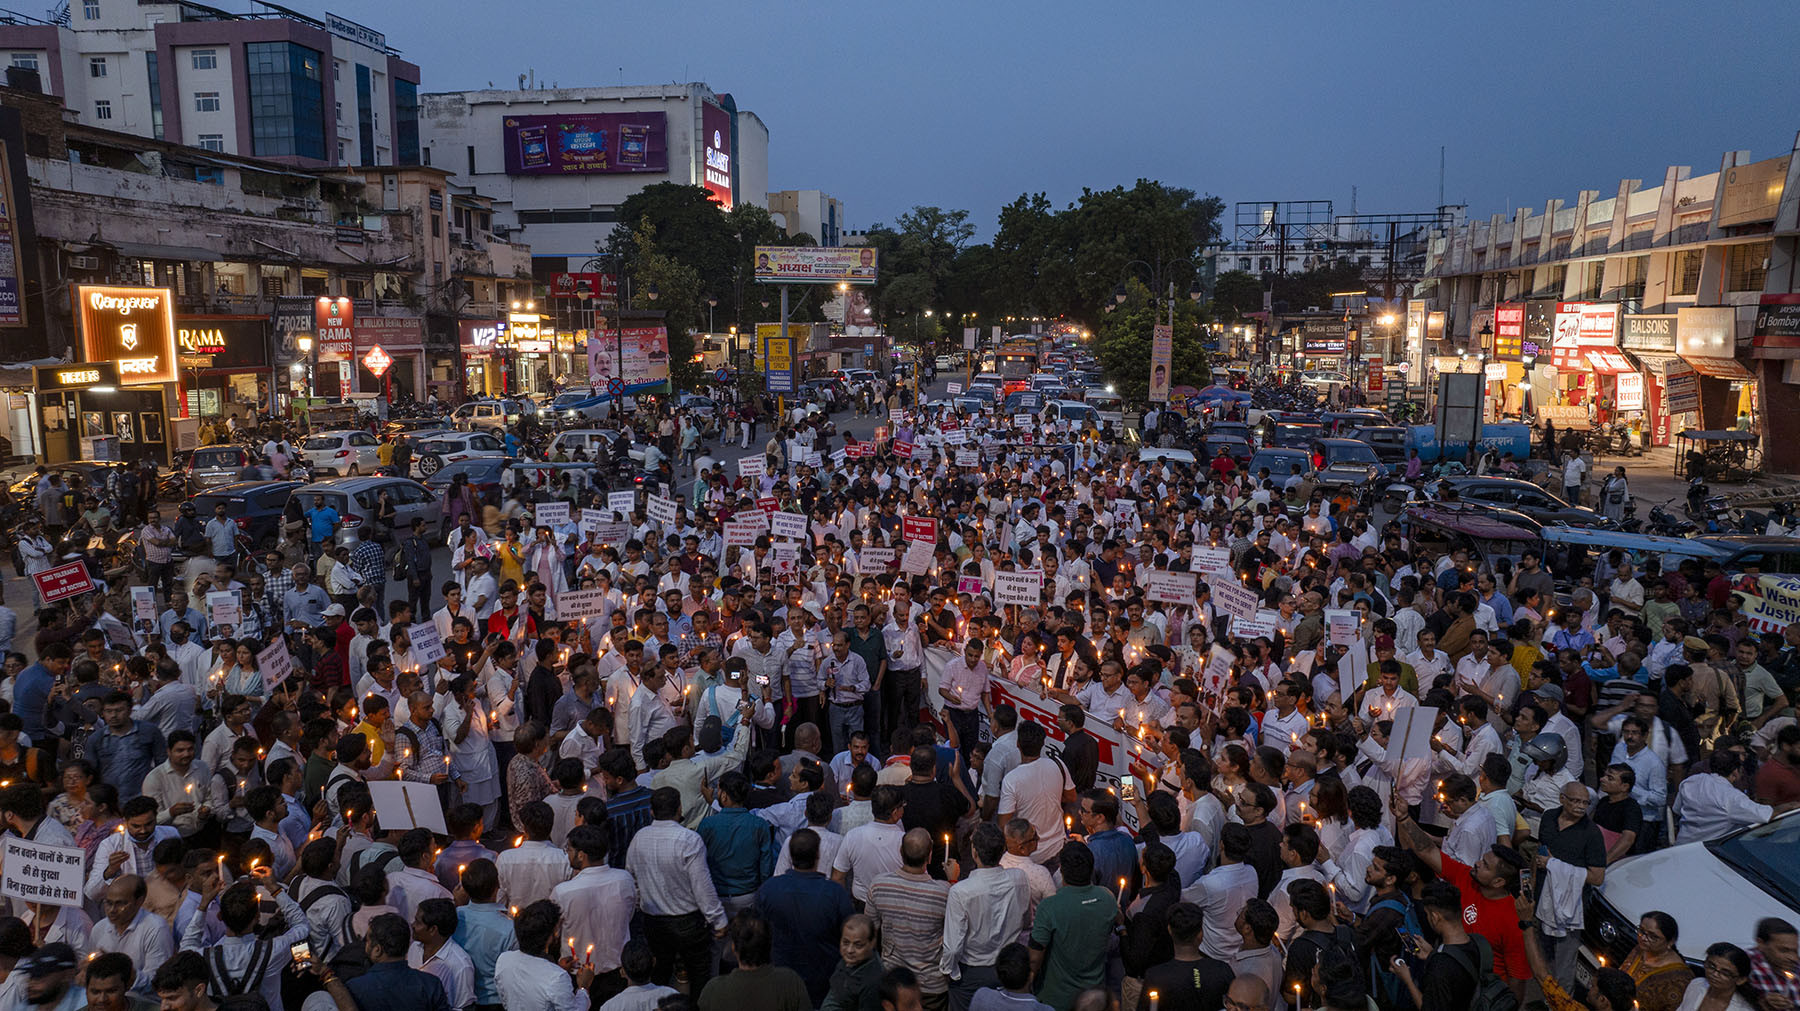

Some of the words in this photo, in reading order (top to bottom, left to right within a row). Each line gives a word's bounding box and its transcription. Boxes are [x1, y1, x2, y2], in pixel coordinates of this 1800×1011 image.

[706, 146, 729, 173] SMART
[706, 168, 730, 188] BAZAAR
[777, 263, 813, 273] अध्यक्ष
[91, 293, 159, 315] Manyavar
[276, 315, 312, 331] FROZEN
[327, 317, 343, 327] NEW
[386, 318, 402, 329] DENTAL
[1326, 325, 1344, 333] STREET
[1767, 316, 1800, 327] Bombay
[178, 329, 227, 351] RAMA
[319, 328, 352, 341] RAMA
[473, 327, 496, 346] VIP
[319, 342, 353, 354] CHEMISTS
[1540, 407, 1587, 418] BALSONS
[41, 574, 54, 582] ZERO
[53, 566, 80, 579] TOLERANCE
[46, 588, 61, 597] ABUSE
[66, 580, 88, 591] DOCTORS
[1217, 581, 1232, 591] JUSTICE
[1232, 587, 1240, 595] FOR
[1239, 591, 1257, 603] DOCTORS
[1224, 601, 1232, 609] NOT
[1240, 601, 1252, 610] SERVE
[8, 844, 20, 856] जान
[38, 850, 56, 863] वालों
[56, 851, 64, 863] के
[65, 854, 81, 866] जान
[22, 864, 31, 877] की
[32, 866, 39, 878] हो
[40, 868, 60, 882] सुरक्षा
[7, 877, 20, 892] बिना
[20, 883, 38, 897] सुरक्षा
[39, 884, 52, 897] कैसे
[53, 886, 61, 898] हो
[62, 885, 77, 900] सेवा
